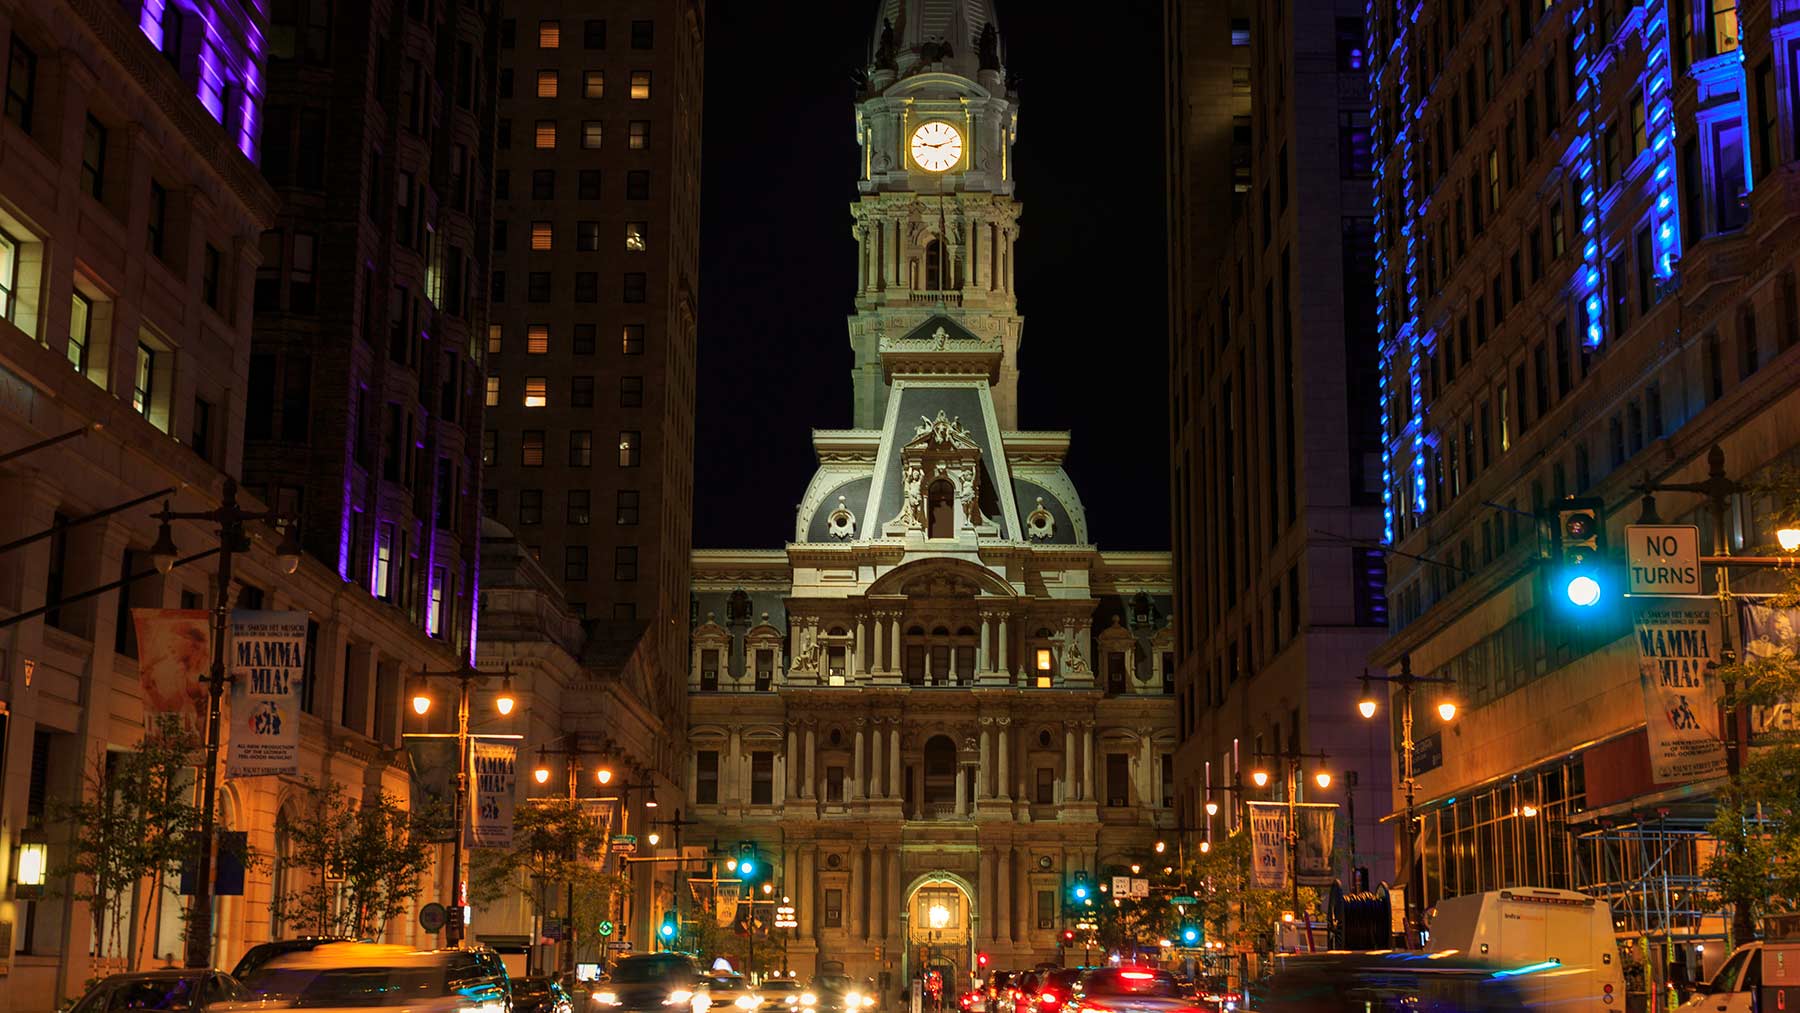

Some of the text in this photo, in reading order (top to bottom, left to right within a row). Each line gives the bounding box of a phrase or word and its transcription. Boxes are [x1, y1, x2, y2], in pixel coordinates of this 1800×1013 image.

[1646, 535, 1678, 557] NO
[1631, 567, 1696, 584] TURNS
[236, 641, 302, 668] MAMMA
[1639, 629, 1710, 657] MAMMA
[250, 669, 289, 694] MIA!
[1658, 660, 1699, 687] MIA!
